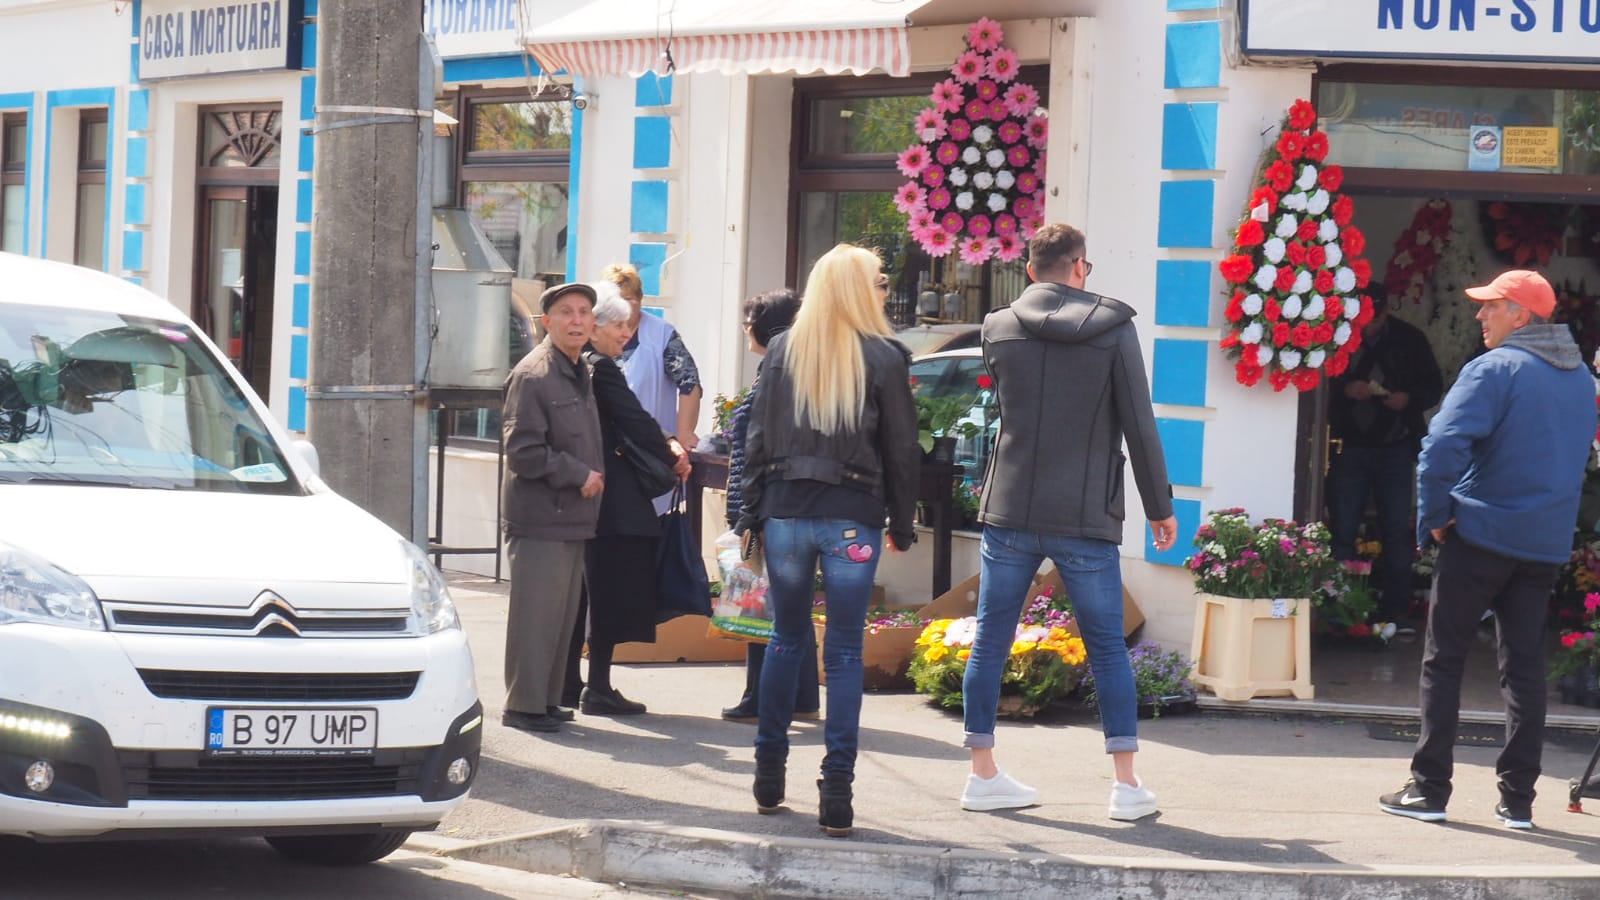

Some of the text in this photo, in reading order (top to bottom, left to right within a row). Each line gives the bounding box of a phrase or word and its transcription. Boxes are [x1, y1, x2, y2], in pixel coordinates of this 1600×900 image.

[144, 0, 281, 60] CASA MORTUARA
[209, 732, 223, 745] RO
[233, 714, 367, 745] B 97 UMP
